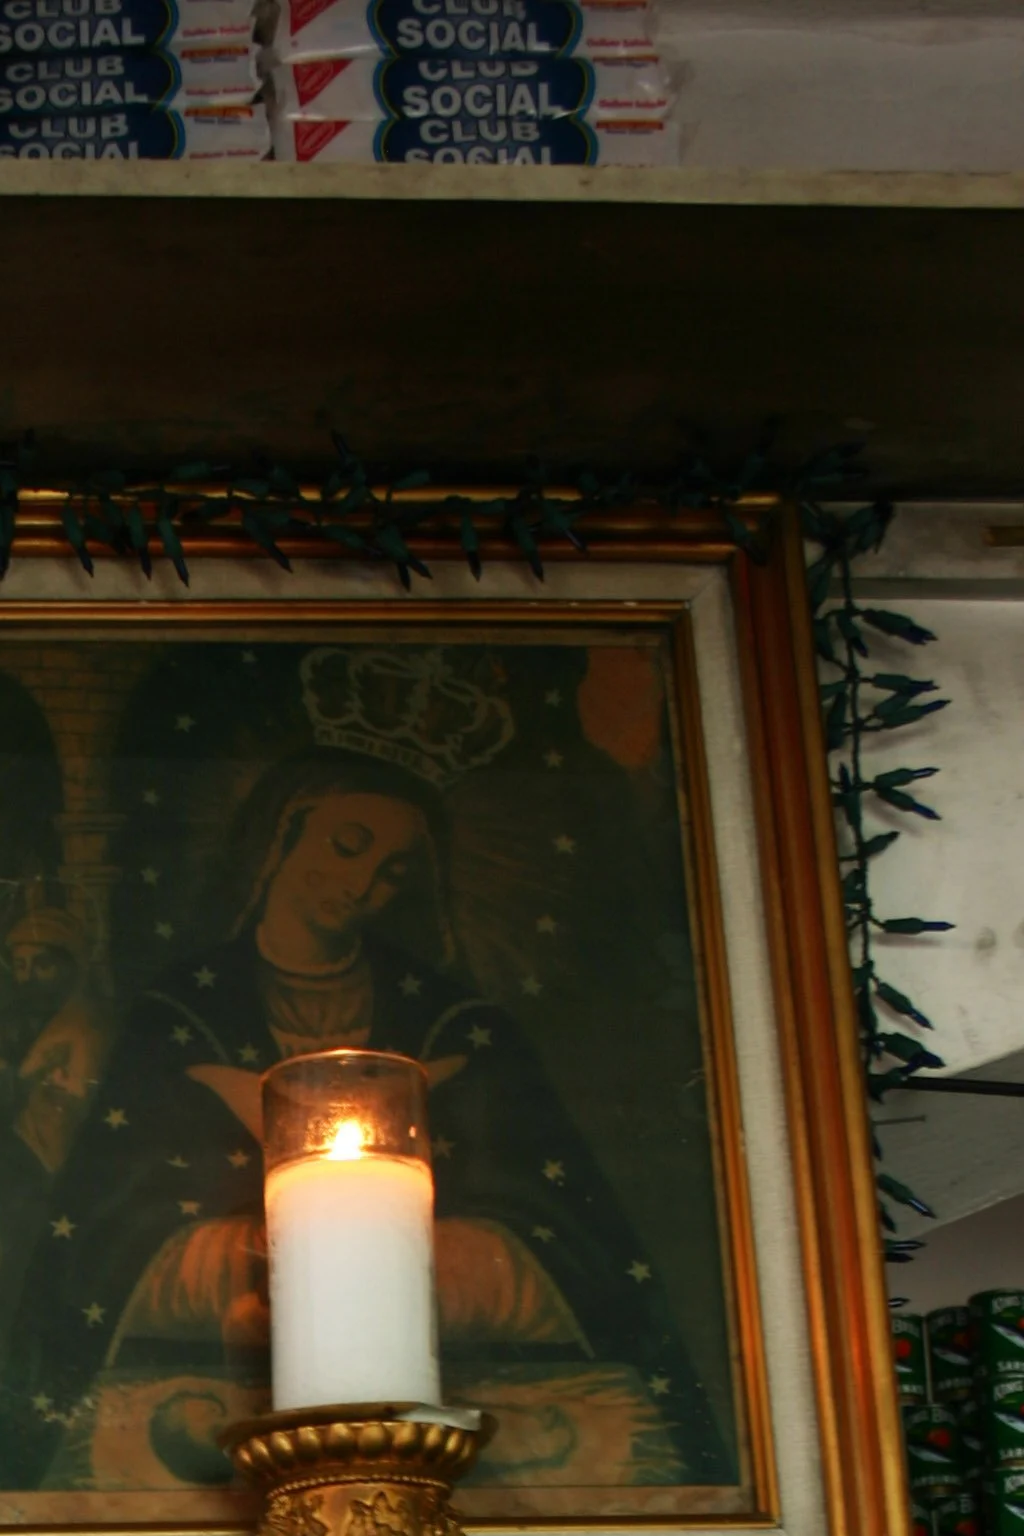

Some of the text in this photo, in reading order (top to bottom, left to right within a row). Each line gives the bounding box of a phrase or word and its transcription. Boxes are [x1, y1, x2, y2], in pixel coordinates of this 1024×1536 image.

[4, 0, 133, 20] CLUB
[396, 17, 554, 56] SOCIAL
[5, 54, 125, 82] CLUB
[418, 60, 539, 83] CLUB
[402, 82, 566, 120] SOCIAL
[7, 114, 130, 141] CLUB
[419, 118, 540, 145] CLUB
[403, 146, 556, 165] SOCIAL
